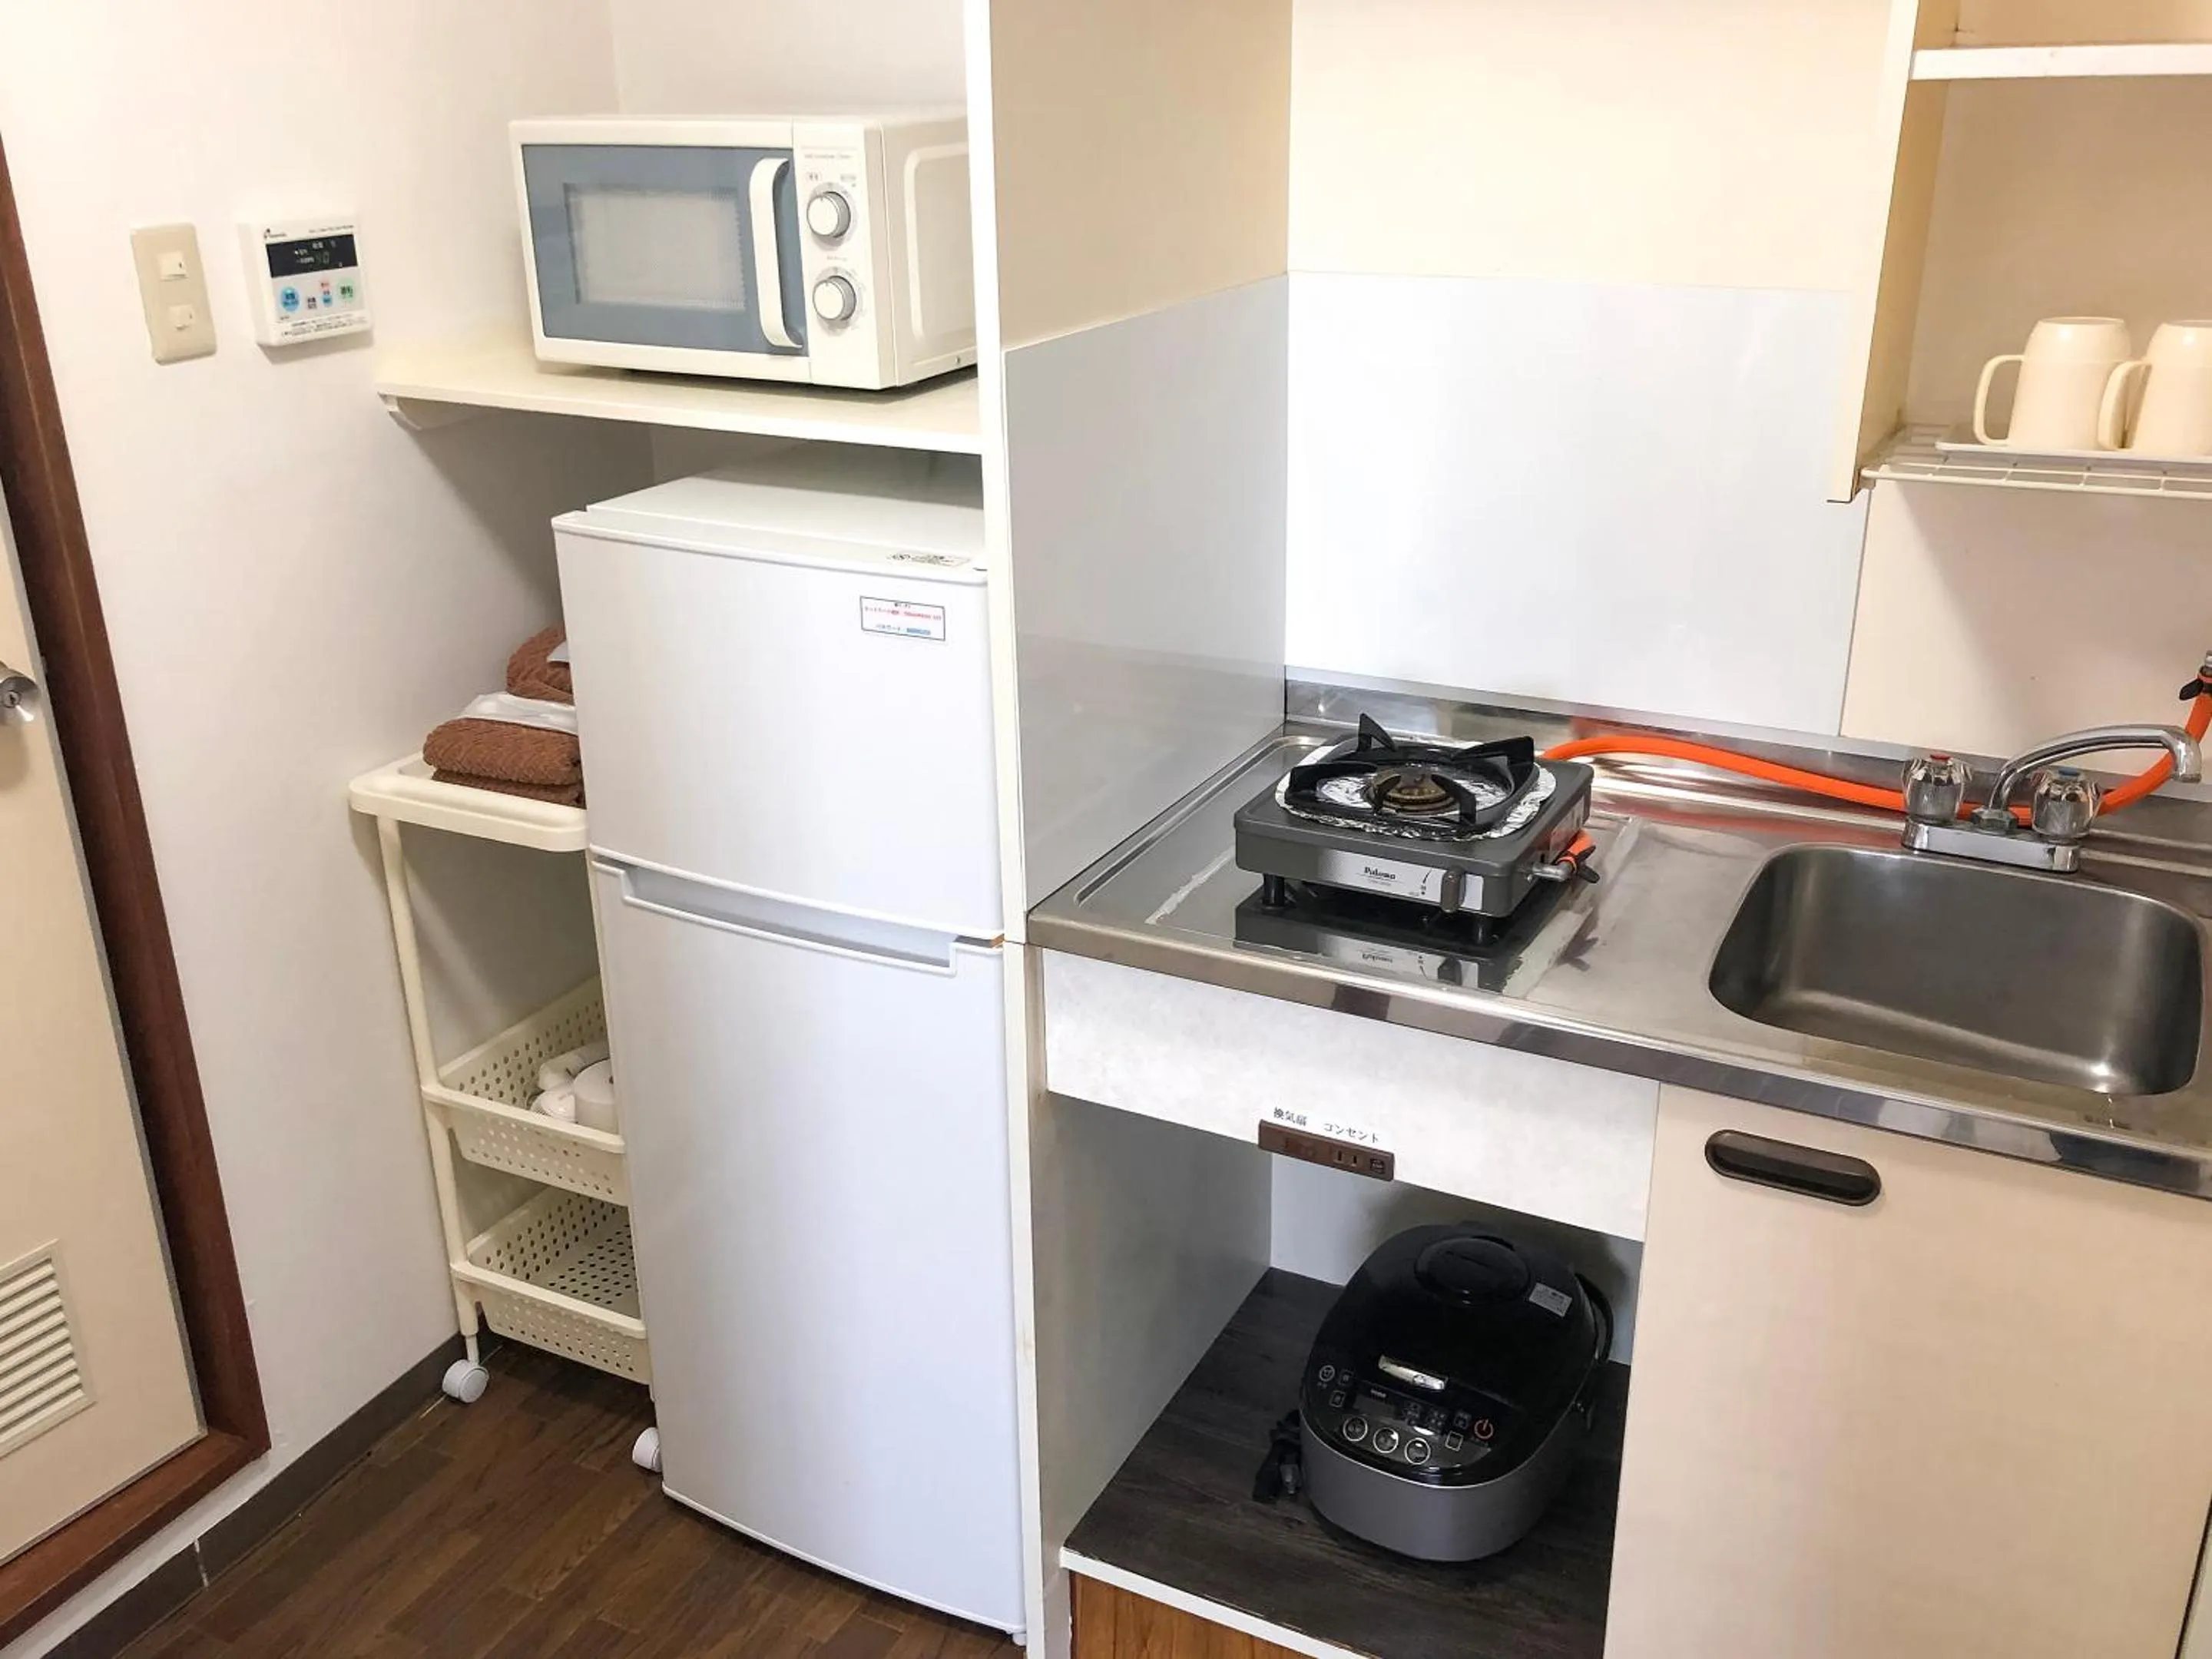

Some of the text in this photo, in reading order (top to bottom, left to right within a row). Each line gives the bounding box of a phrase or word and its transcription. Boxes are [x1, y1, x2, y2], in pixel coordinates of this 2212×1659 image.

[1273, 1106, 1379, 1143] 換気扇 コンセント
